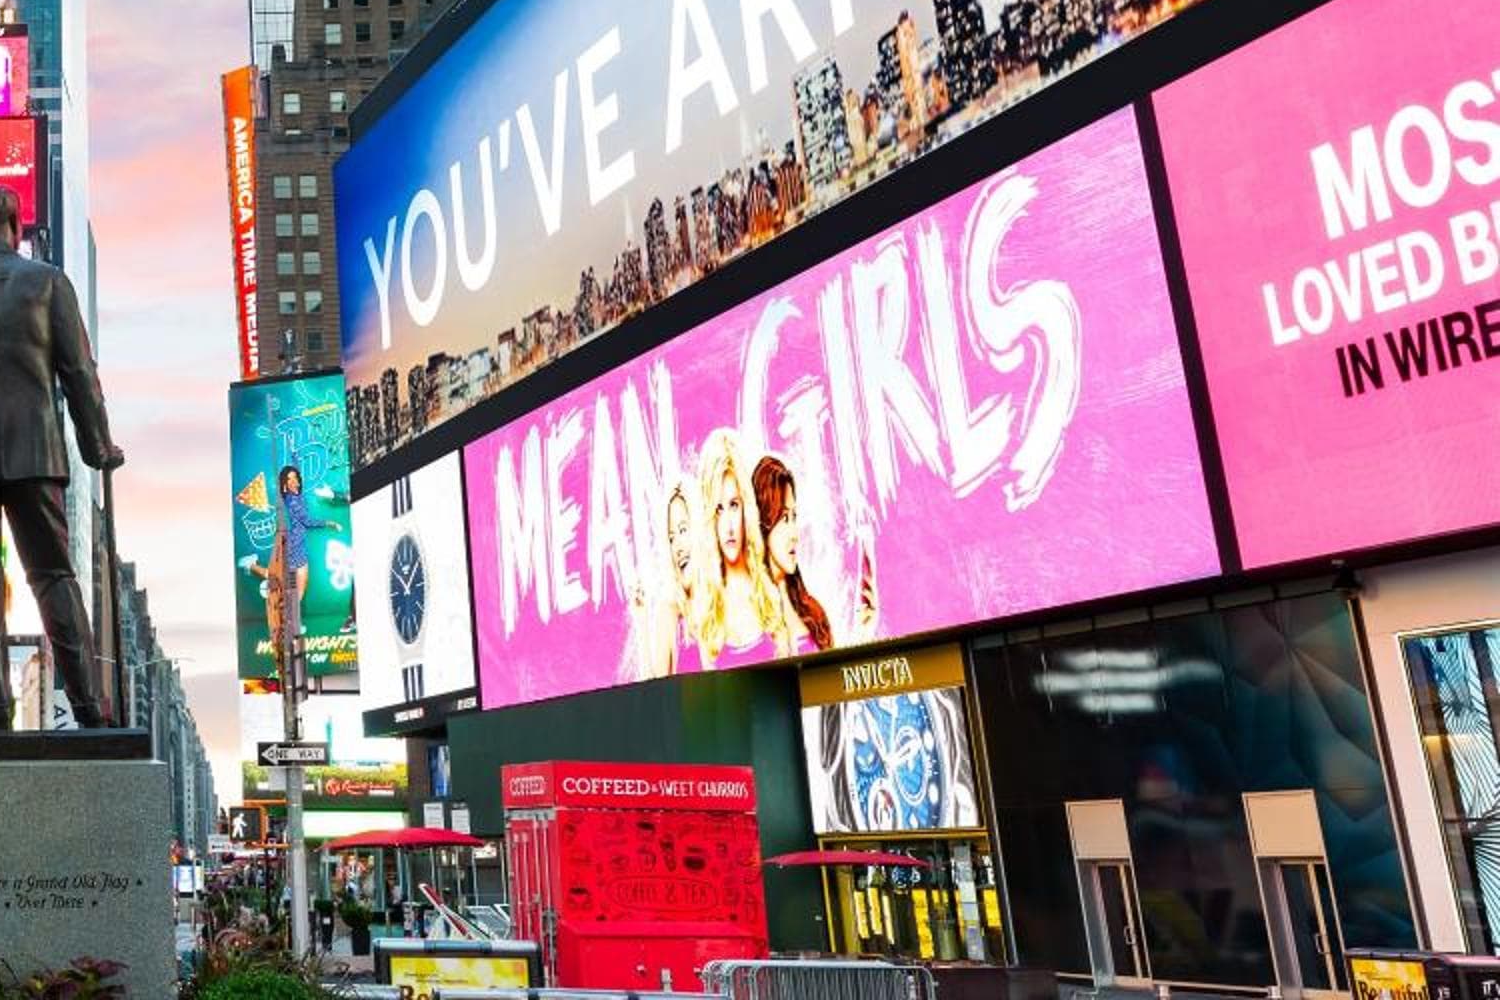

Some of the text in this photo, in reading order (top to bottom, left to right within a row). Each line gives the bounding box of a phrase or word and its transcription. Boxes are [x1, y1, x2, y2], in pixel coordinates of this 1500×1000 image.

[363, 27, 636, 351] YOU'VE
[1310, 69, 1500, 240] MOS
[231, 116, 260, 373] AMERICA TIME MEDIA
[1262, 230, 1445, 347] LOVED
[737, 167, 1082, 538] GIRLS
[1335, 300, 1500, 398] IN WIRE
[495, 358, 690, 640] MEAN
[842, 657, 915, 693] INVICTA
[267, 750, 321, 760] ONE WAY
[562, 777, 650, 797] COFFEED
[659, 780, 694, 798] SWEET
[699, 780, 749, 799] CHURROS
